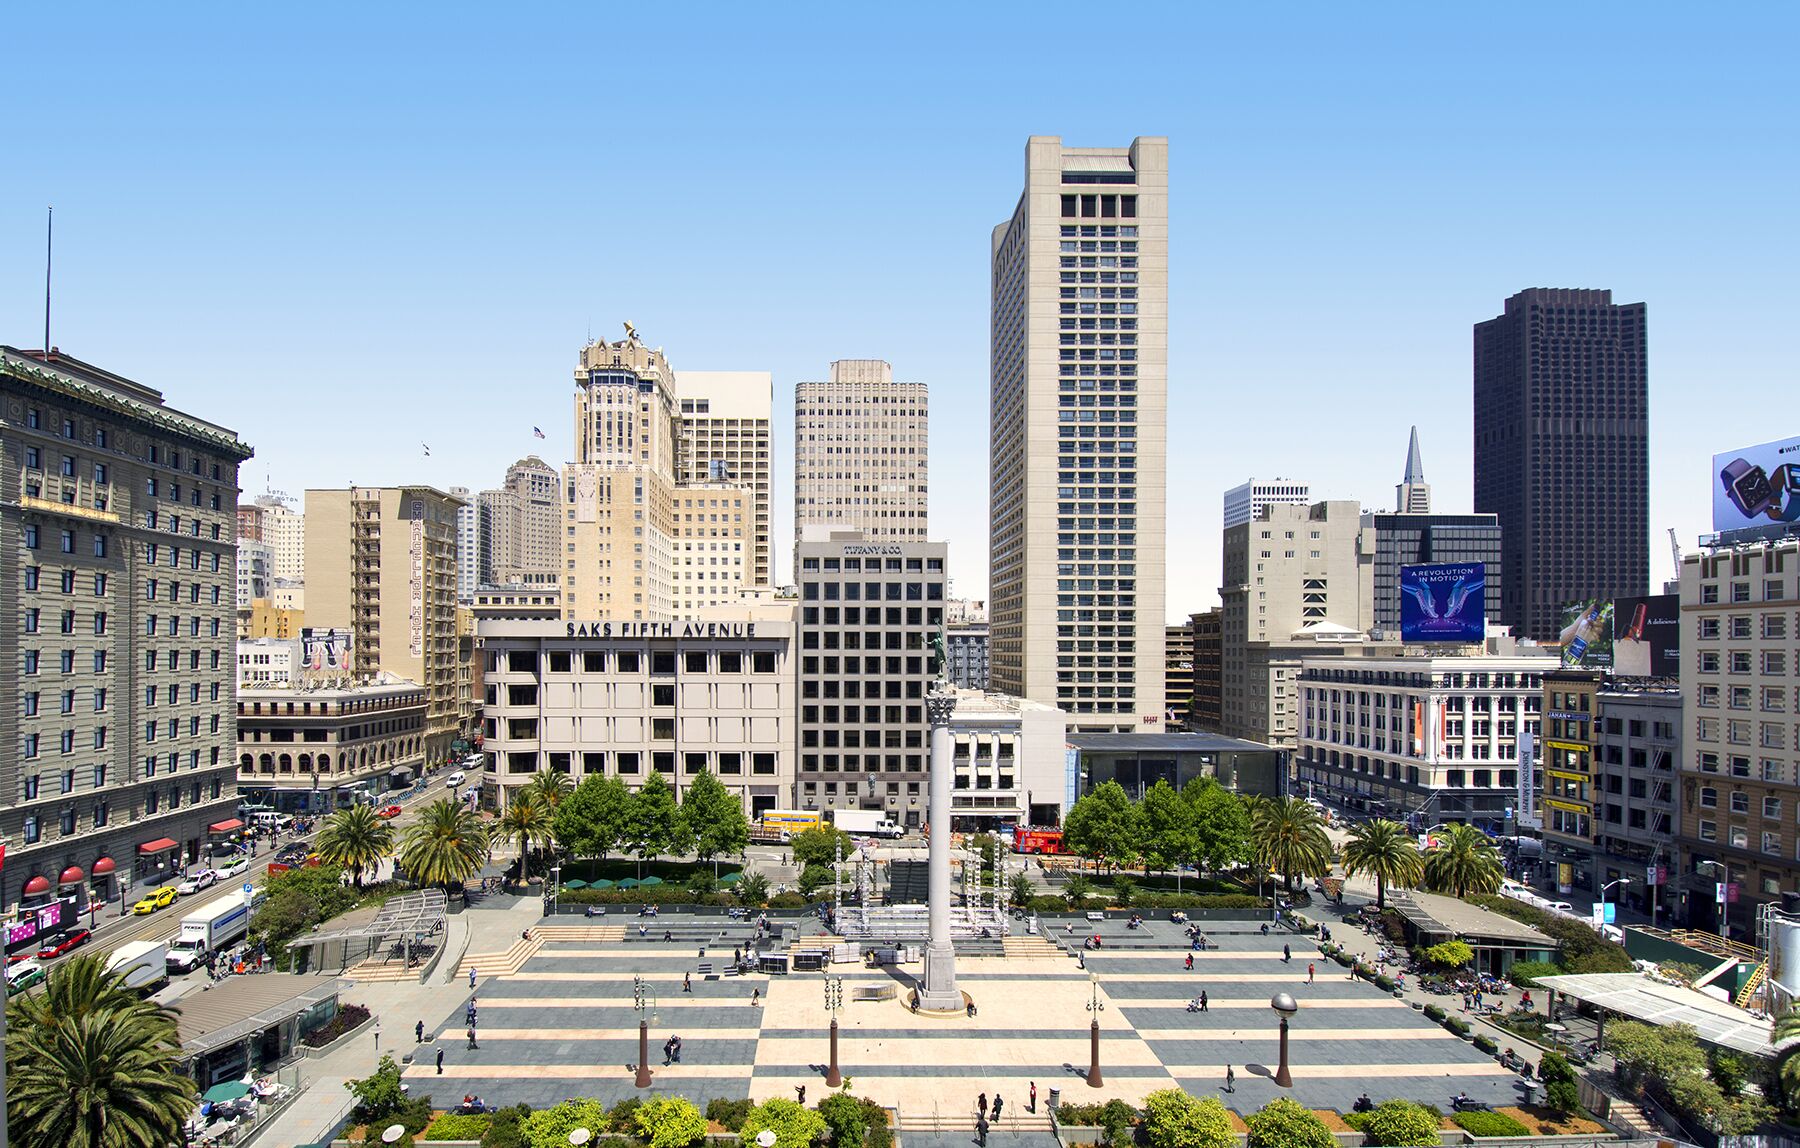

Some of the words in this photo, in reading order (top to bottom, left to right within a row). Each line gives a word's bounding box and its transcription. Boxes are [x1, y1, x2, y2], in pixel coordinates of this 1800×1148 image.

[412, 501, 422, 600] CHANCELLOR
[844, 546, 880, 555] TIFFANY
[881, 546, 888, 555] &
[1418, 568, 1474, 577] REVOLUTION
[412, 605, 422, 655] HOTEL
[566, 622, 612, 638] SAKS
[622, 622, 672, 638] FIFTH
[683, 622, 756, 638] AVENUE
[306, 641, 345, 656] DSW
